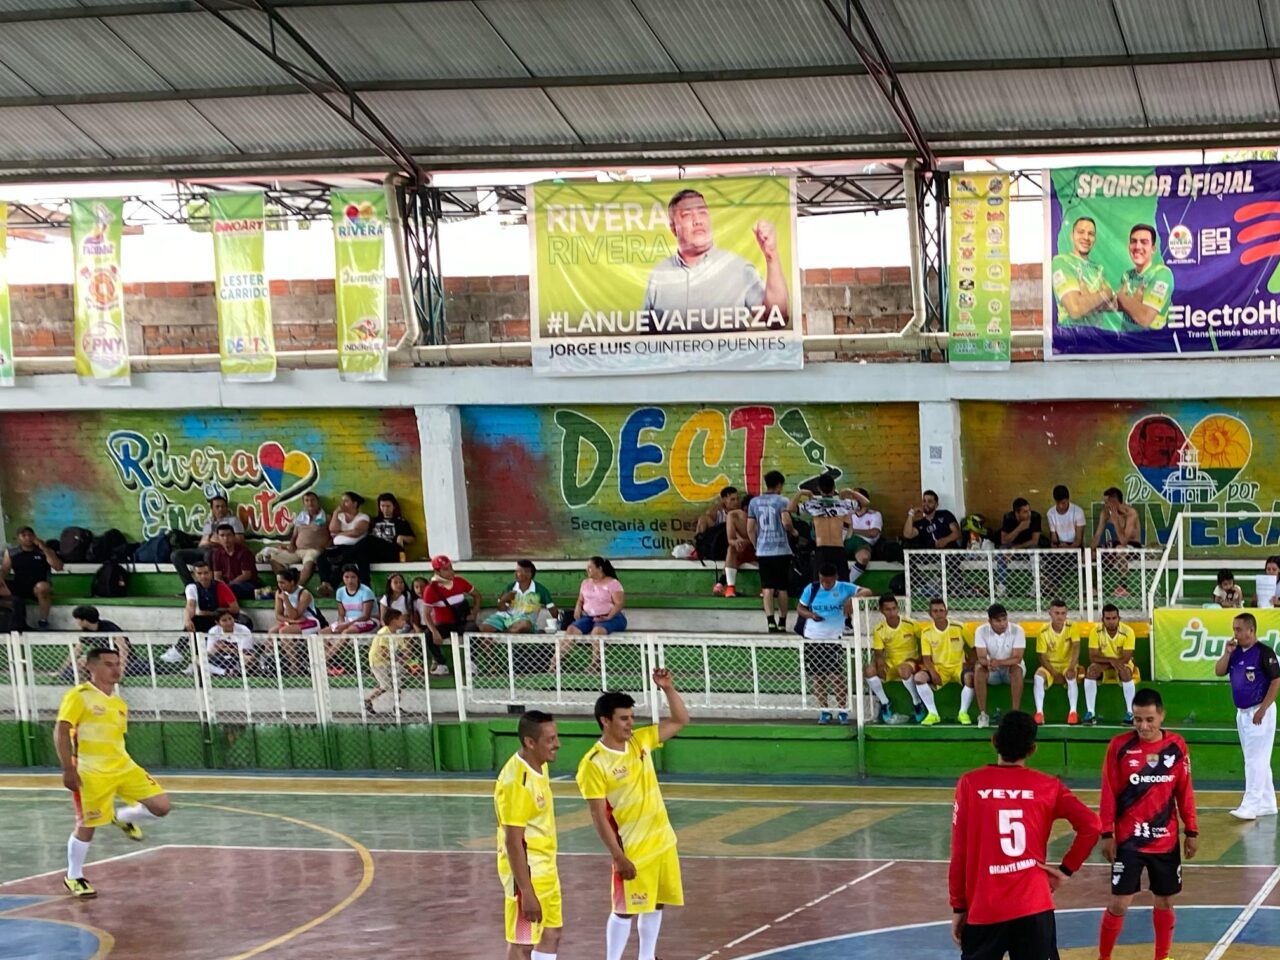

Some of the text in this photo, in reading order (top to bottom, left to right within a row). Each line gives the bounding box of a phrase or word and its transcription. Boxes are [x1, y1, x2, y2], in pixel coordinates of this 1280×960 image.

[1076, 170, 1254, 199] SPONSOR OFICIAL
[546, 201, 669, 233] RIVERA
[338, 225, 384, 238] RIVERA
[548, 234, 672, 266] RIVERA
[223, 273, 265, 287] LESTER
[547, 304, 787, 335] #LANUEVAFUERZA
[1187, 328, 1241, 339] Transmitimos
[1242, 327, 1268, 337] Buena
[92, 337, 124, 352] PNY
[549, 336, 786, 359] JORGE LUIS QUINTERO PUENTES
[106, 429, 259, 491] Rivera
[1123, 474, 1152, 504] De
[1226, 480, 1260, 501] por
[140, 486, 295, 541] Encnto
[570, 516, 645, 532] Secretaría
[650, 518, 668, 531] de
[1140, 774, 1176, 783] NEODENT
[977, 788, 1035, 800] YEYE
[998, 809, 1026, 857] 5
[988, 862, 1016, 875] GIGANTE
